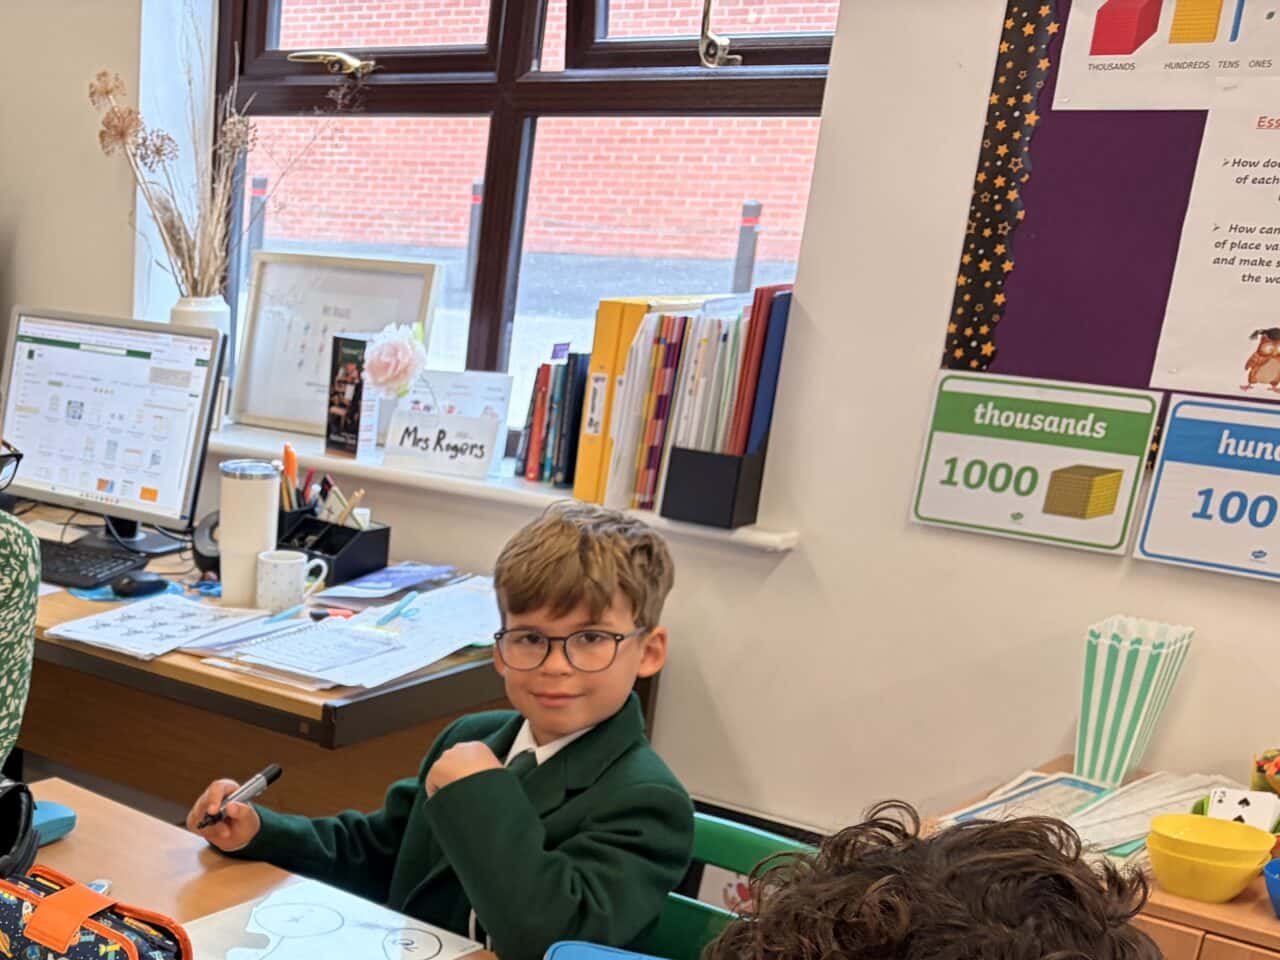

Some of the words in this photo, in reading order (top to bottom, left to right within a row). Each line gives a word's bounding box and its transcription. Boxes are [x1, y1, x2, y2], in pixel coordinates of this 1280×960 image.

[1087, 62, 1136, 72] THOUSANDS
[1163, 60, 1211, 70] HUNDREDS
[1217, 60, 1240, 69] TENS
[1248, 59, 1273, 69] ONES
[1232, 158, 1260, 168] How
[1236, 174, 1250, 184] of
[1229, 223, 1257, 234] How
[1214, 239, 1228, 249] of
[1230, 240, 1261, 251] place
[1212, 256, 1236, 265] and
[1239, 257, 1272, 267] make
[1241, 273, 1261, 283] the
[973, 401, 1107, 439] thousands
[399, 426, 430, 451] Mrs
[938, 457, 1039, 497] 1000
[1191, 487, 1278, 528] 100
